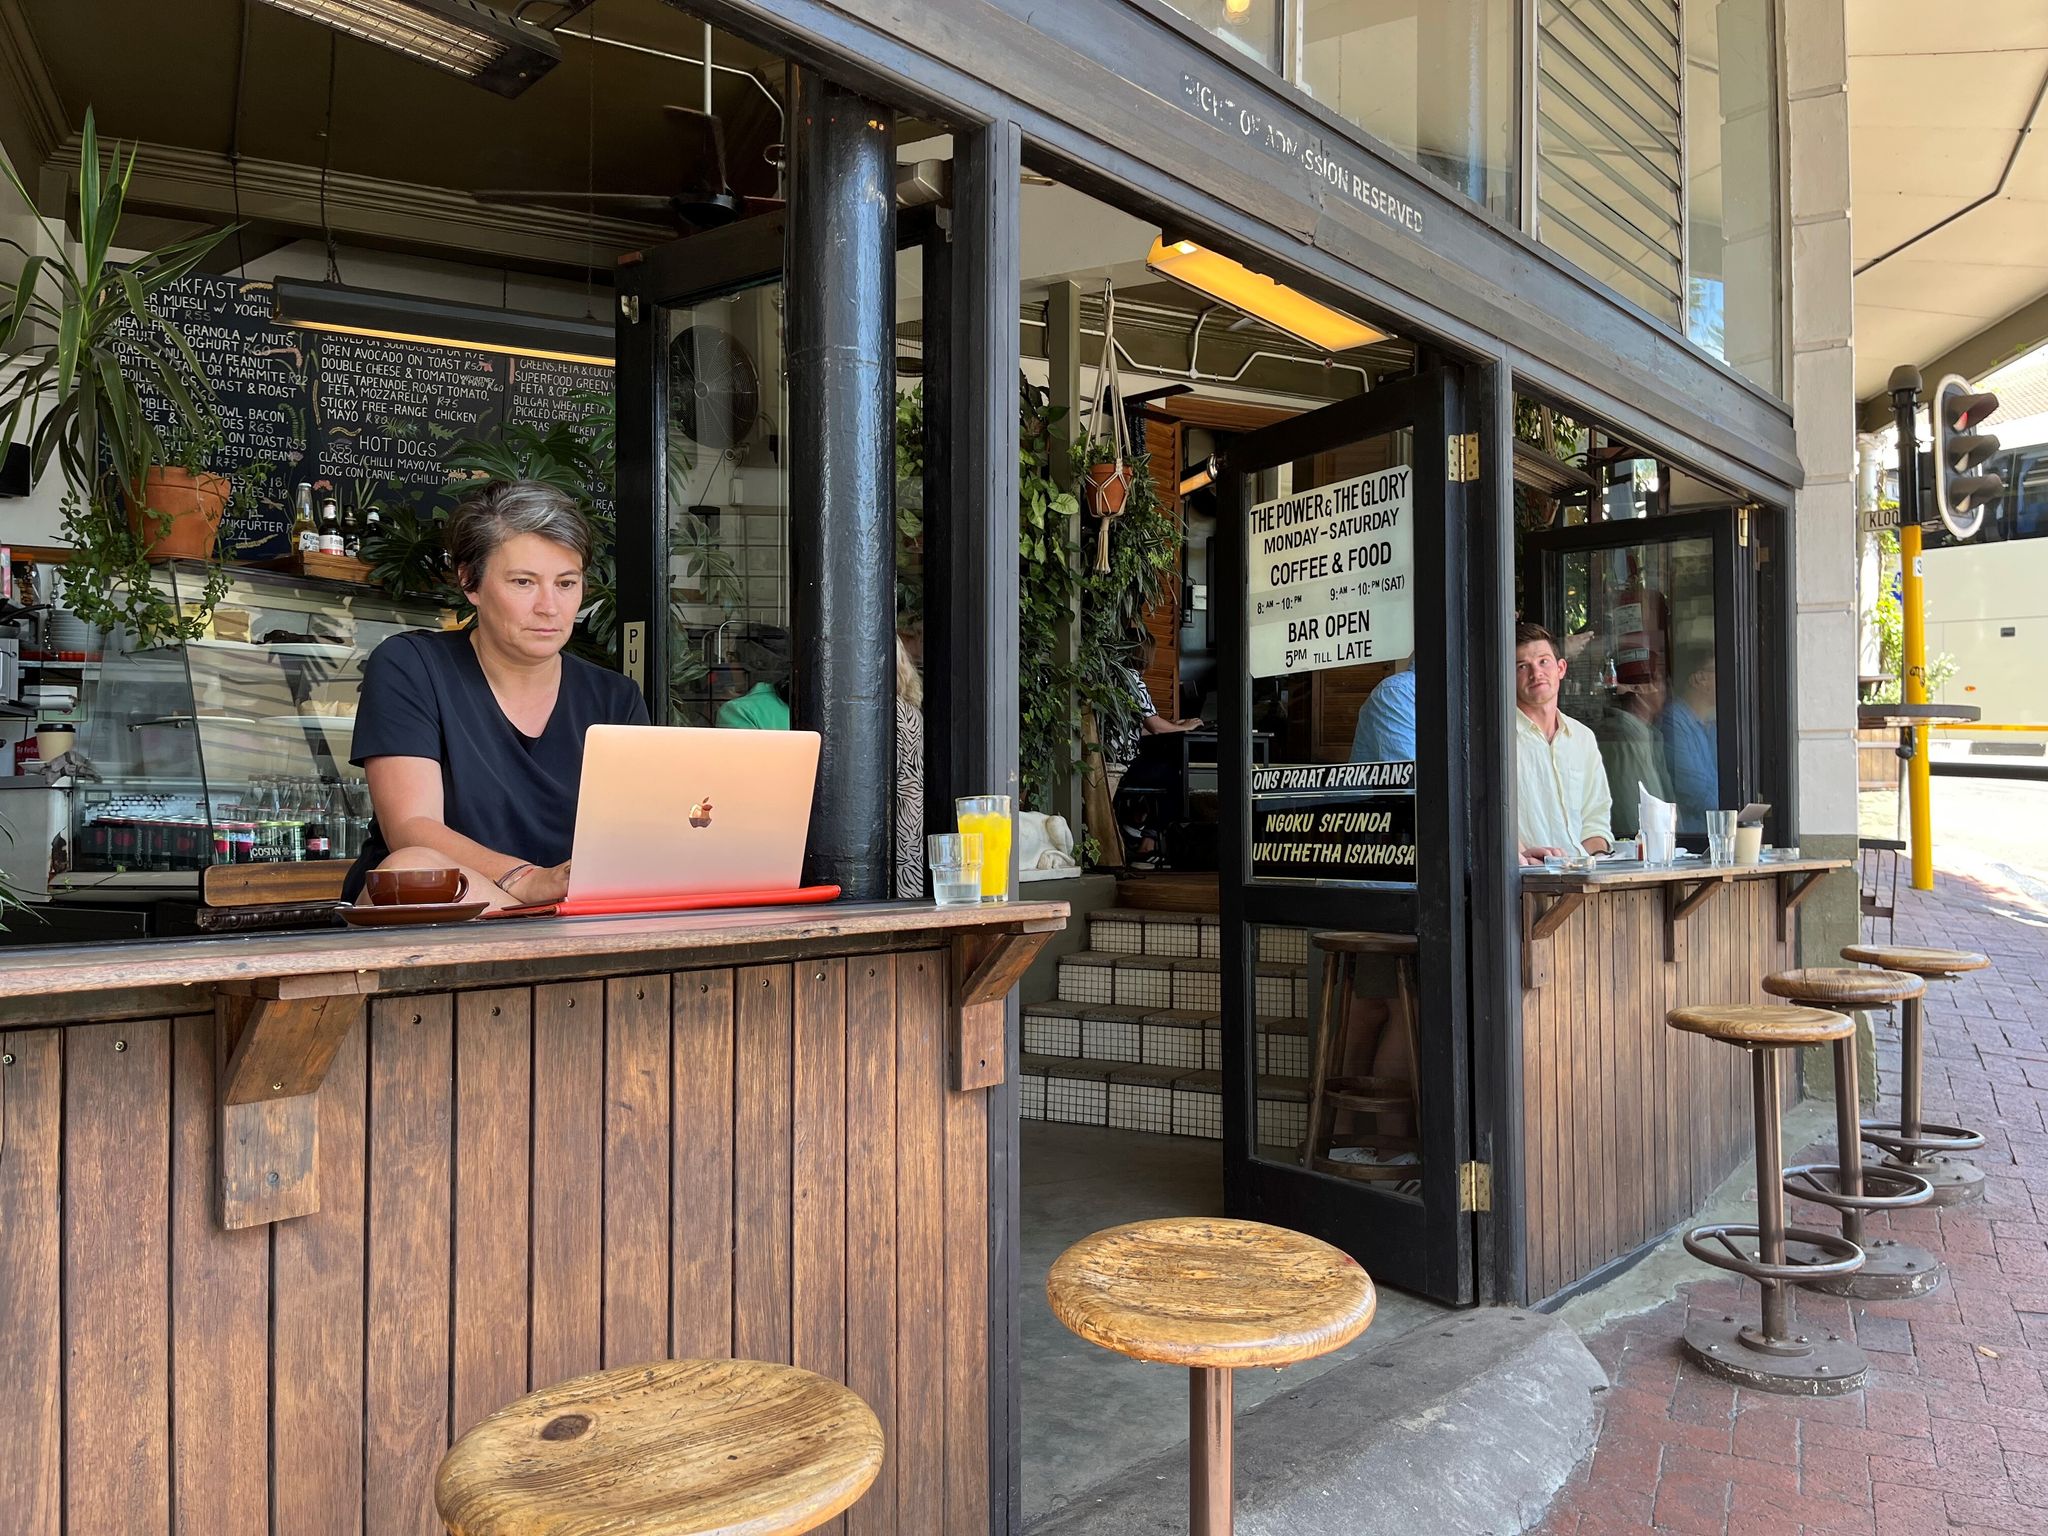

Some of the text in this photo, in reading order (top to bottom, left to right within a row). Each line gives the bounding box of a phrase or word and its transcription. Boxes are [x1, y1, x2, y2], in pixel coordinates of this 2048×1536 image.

[1353, 174, 1423, 233] RESERVED
[163, 294, 207, 311] MUESLI
[243, 293, 272, 305] UNTIL
[164, 332, 174, 346] &
[185, 335, 239, 352] OGHURT
[184, 323, 240, 341] GRANOLA
[321, 343, 351, 358] OPEN
[354, 347, 404, 364] AVOCADO
[407, 353, 423, 366] ON
[428, 356, 461, 371] TOAST
[207, 363, 222, 376] OR
[228, 366, 286, 384] MARMITE
[321, 357, 363, 373] DOUBLE
[366, 363, 401, 378] CHEESE
[404, 367, 413, 380] &
[416, 368, 460, 385] TOMATO
[321, 371, 350, 385] OLIVE
[514, 370, 573, 387] SUPERFOOD
[576, 378, 608, 391] GREEN
[247, 382, 256, 395] &
[258, 383, 297, 398] ROAST
[360, 387, 428, 405] MOZZARELLA
[520, 382, 544, 395] FETA
[547, 385, 555, 397] &
[320, 396, 358, 411] STICKY
[434, 408, 477, 424] CHICKEN
[513, 394, 549, 409] BULGAR
[169, 411, 179, 424] &
[248, 421, 274, 435] R65
[327, 408, 359, 422] MAYO
[515, 405, 550, 420] PICKLED
[551, 409, 579, 423] GREEN
[229, 431, 245, 444] ON
[248, 433, 285, 448] TOAST
[359, 435, 392, 453] HOT
[397, 438, 437, 458] DOGS
[319, 464, 342, 477] DOG
[345, 466, 364, 478] CON
[365, 468, 396, 481] CARNE
[1250, 471, 1409, 534] THE POWER & THE GLORY
[1270, 541, 1392, 586] COFFEE & FOOD
[1288, 609, 1370, 643] BAR OPEN
[1285, 639, 1372, 668] 5PM TILL LATE
[1253, 763, 1413, 790] ONS PRAAT AFRIKAANS
[1265, 812, 1392, 833] NGOKU SIFUNDA
[1252, 842, 1415, 866] UKUTHETHA ISIXHOSA
